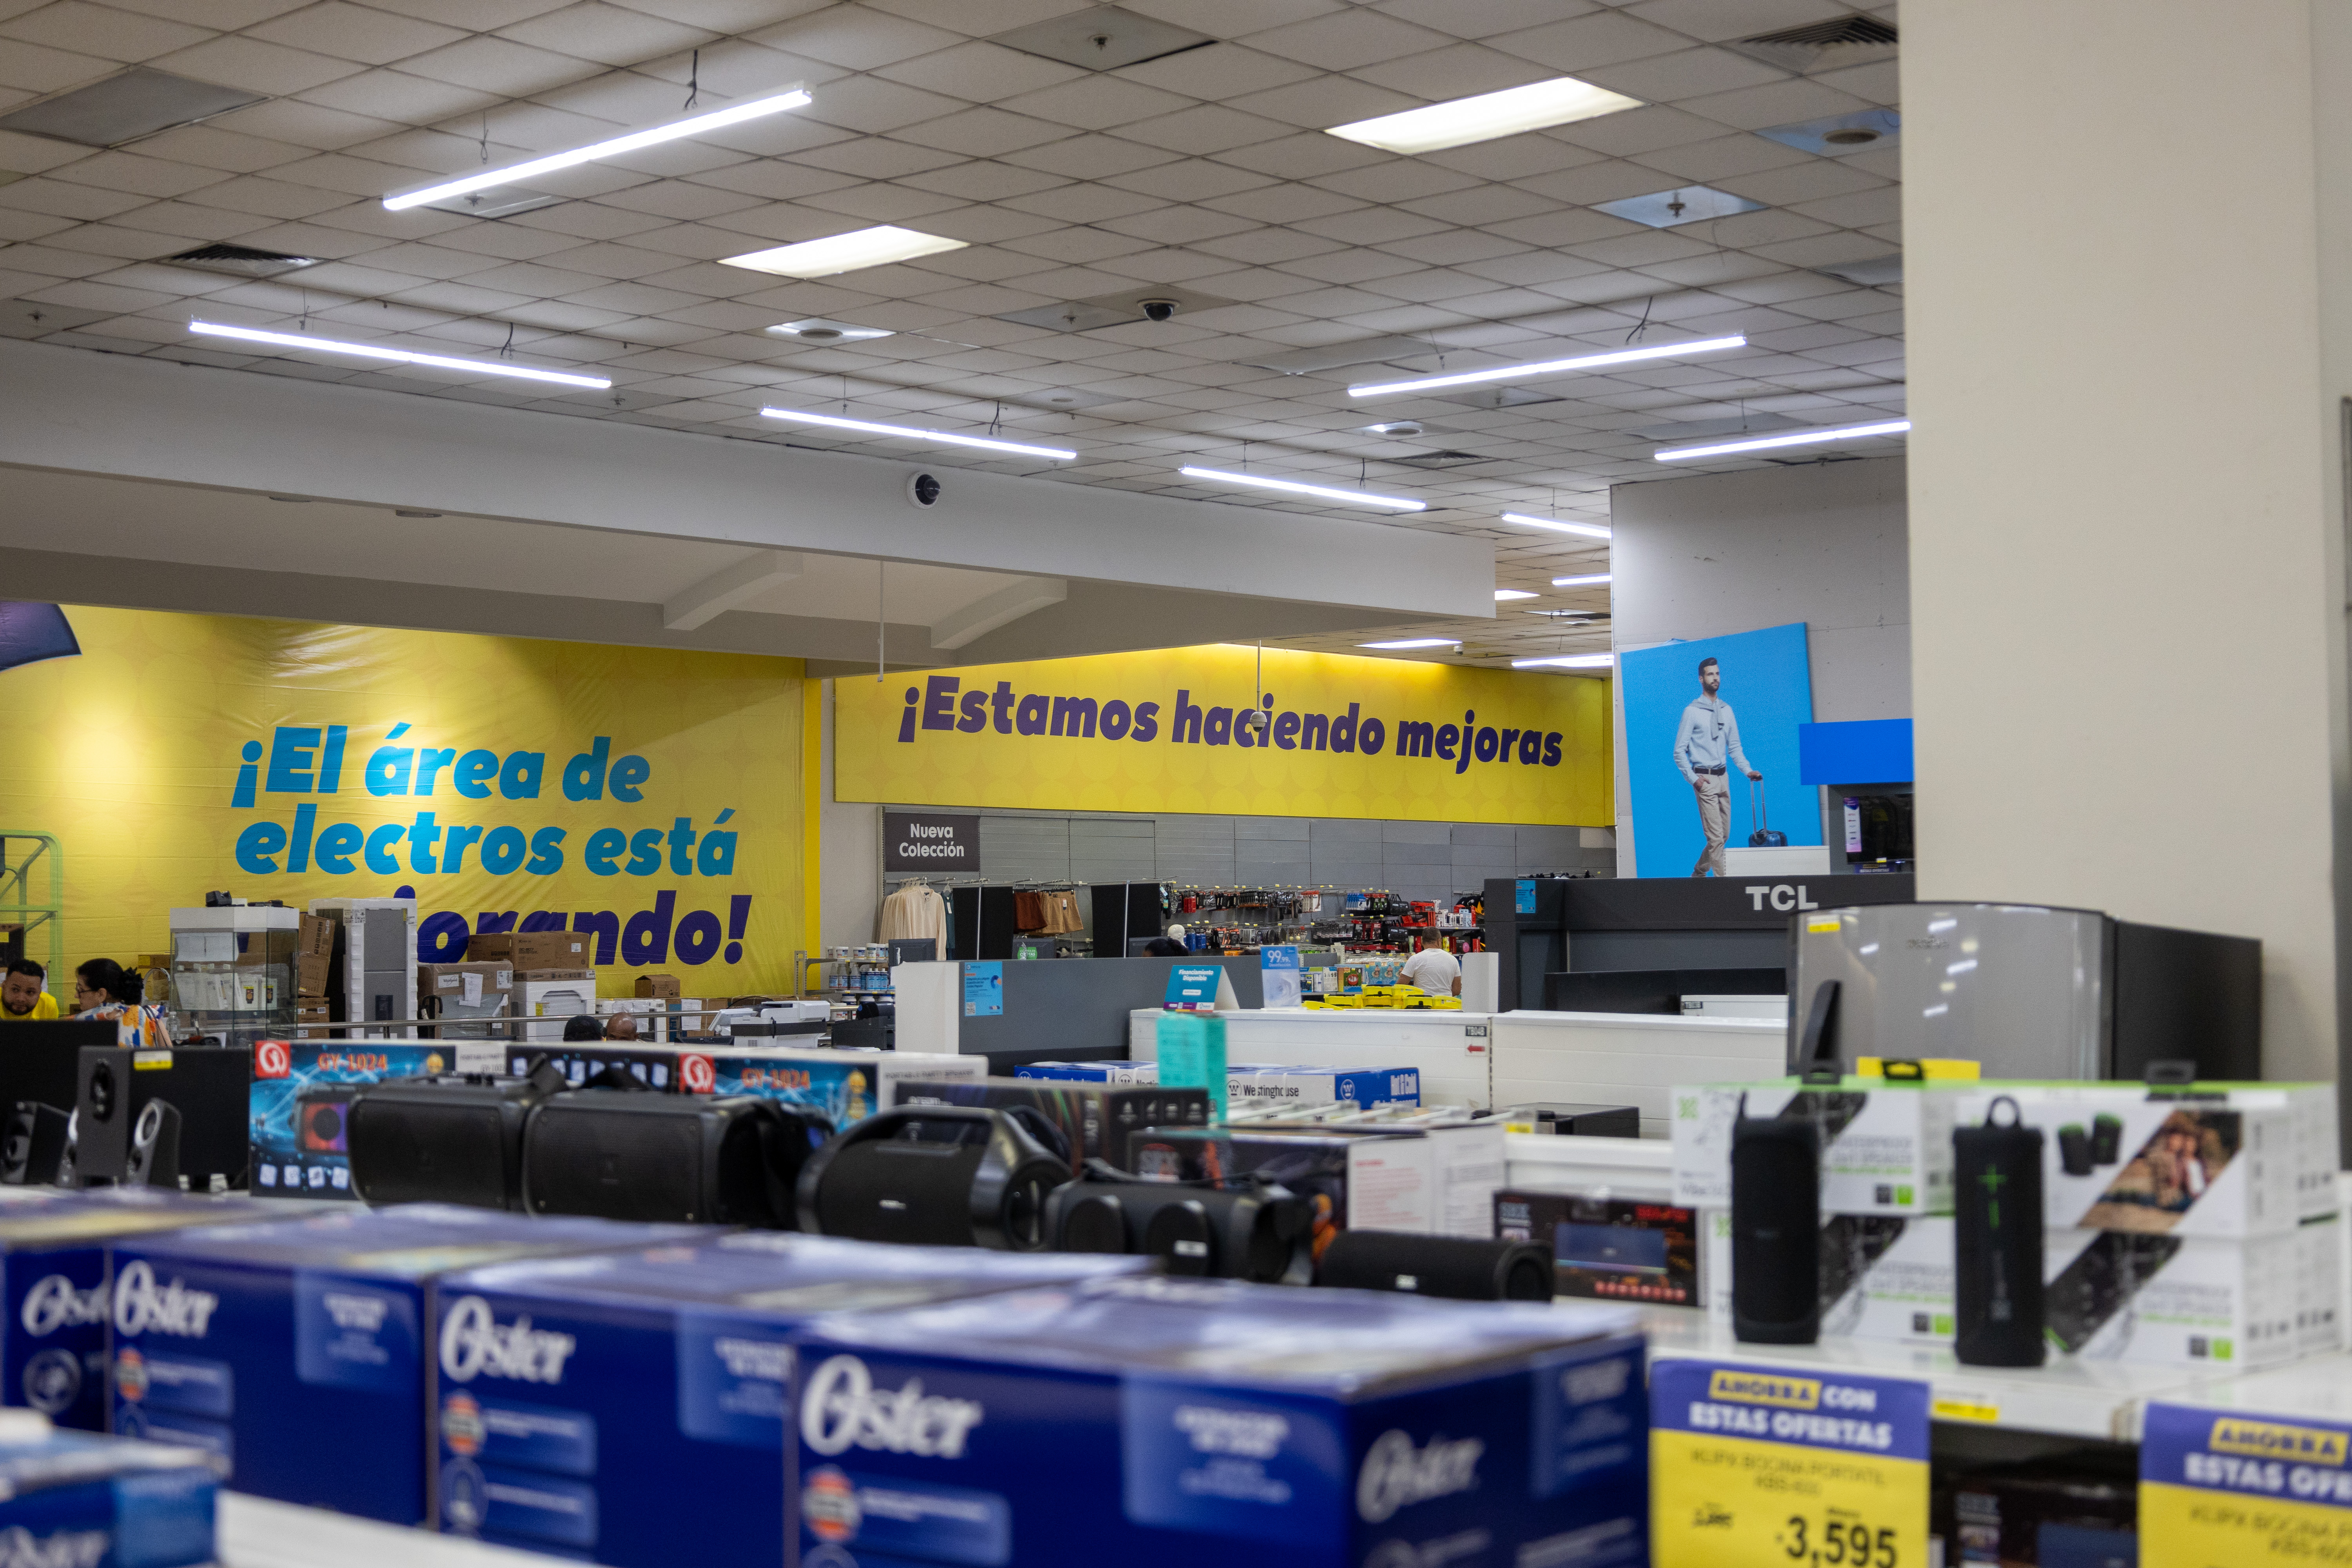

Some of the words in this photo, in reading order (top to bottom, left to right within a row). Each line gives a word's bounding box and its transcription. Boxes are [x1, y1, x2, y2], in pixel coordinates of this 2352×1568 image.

[898, 675, 1160, 743] ¡Estamos
[1172, 689, 1385, 755] haciendo
[1396, 708, 1564, 775] mejoras
[231, 725, 347, 808] ¡El
[365, 722, 545, 799] área
[563, 736, 651, 803] de
[235, 803, 566, 875] electros
[584, 808, 739, 877] está
[900, 841, 964, 857] Colección
[911, 824, 953, 838] Nueva
[1746, 884, 1818, 911] TCL
[318, 1053, 387, 1071] GY-1024
[741, 1067, 810, 1090] GY-1024
[116, 1259, 219, 1338] Oster
[440, 1295, 576, 1385] Oster
[801, 1354, 984, 1459] Oster
[1718, 1378, 1811, 1401] AHORRA
[1822, 1385, 1876, 1412] CON
[1688, 1402, 1767, 1434] ESTAS
[1772, 1413, 1892, 1450] OFERTAS
[2219, 1426, 2337, 1457] AHORRA
[2184, 1453, 2283, 1492] ESTAS
